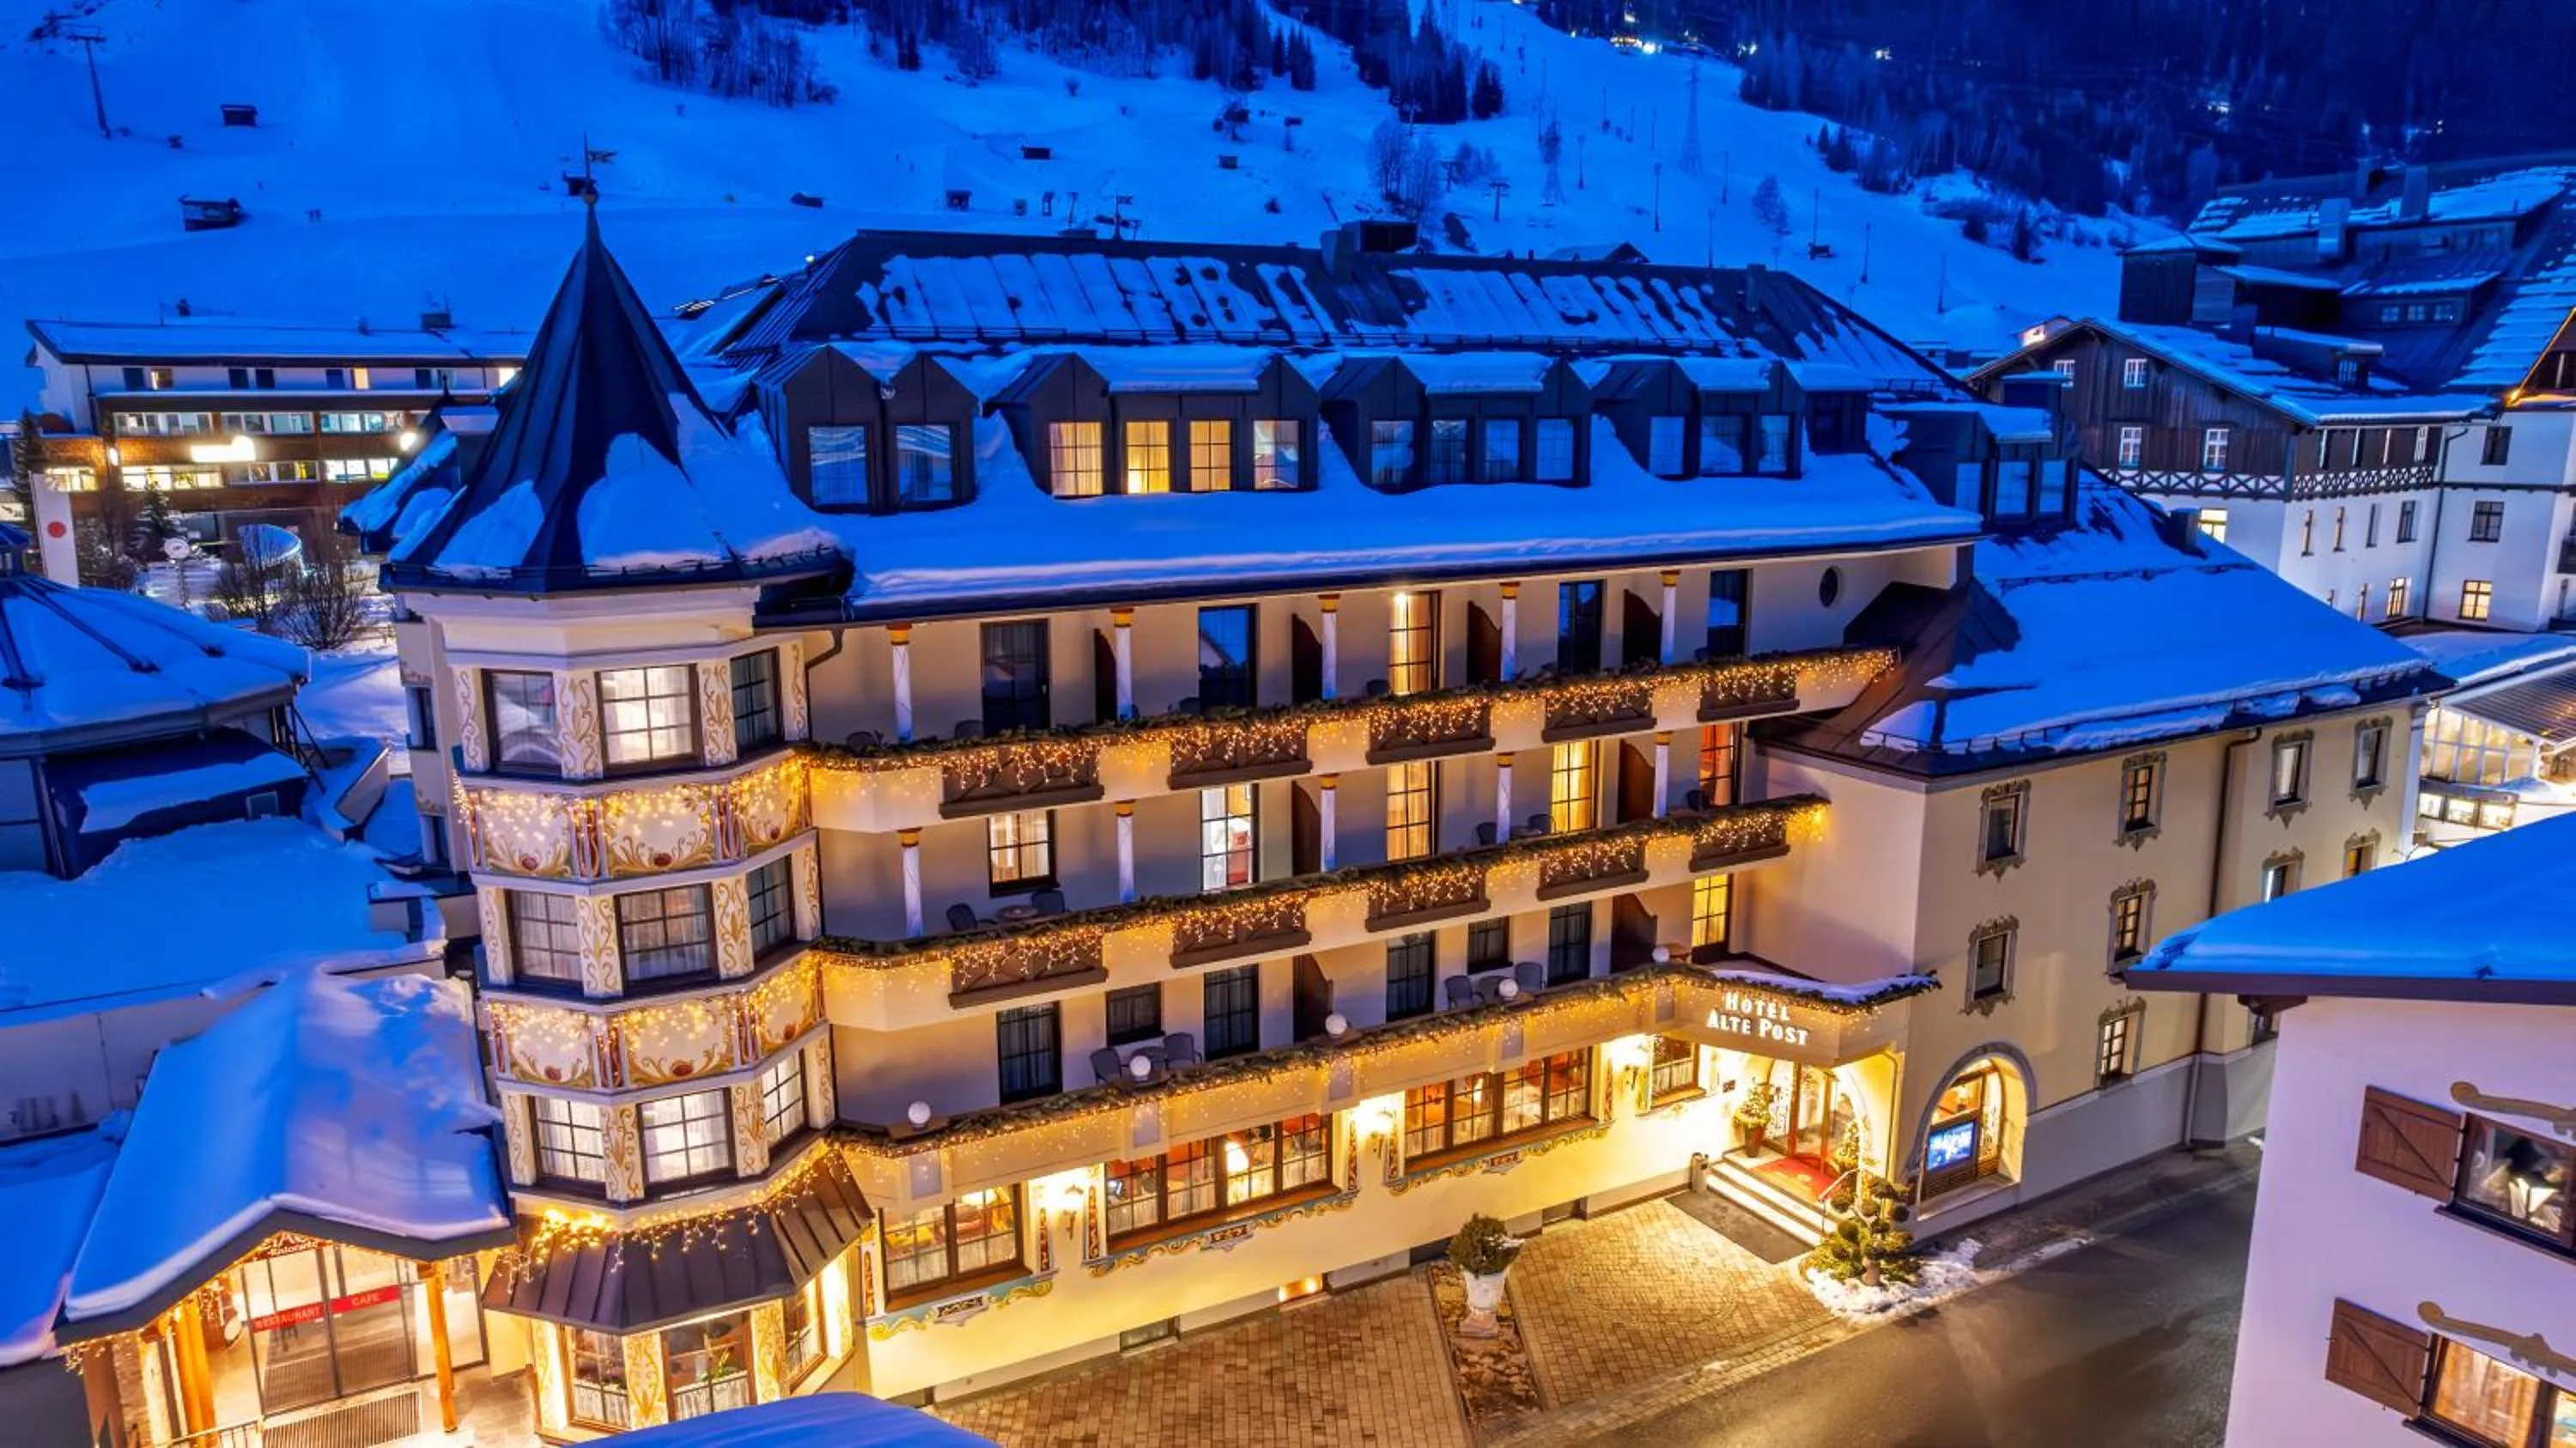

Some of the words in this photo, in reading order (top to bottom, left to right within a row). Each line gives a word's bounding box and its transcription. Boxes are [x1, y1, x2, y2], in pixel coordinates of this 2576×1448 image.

[1725, 992, 1790, 1021] HOTEL
[1706, 1009, 1752, 1035] ALTE
[1758, 1018, 1809, 1045] POST
